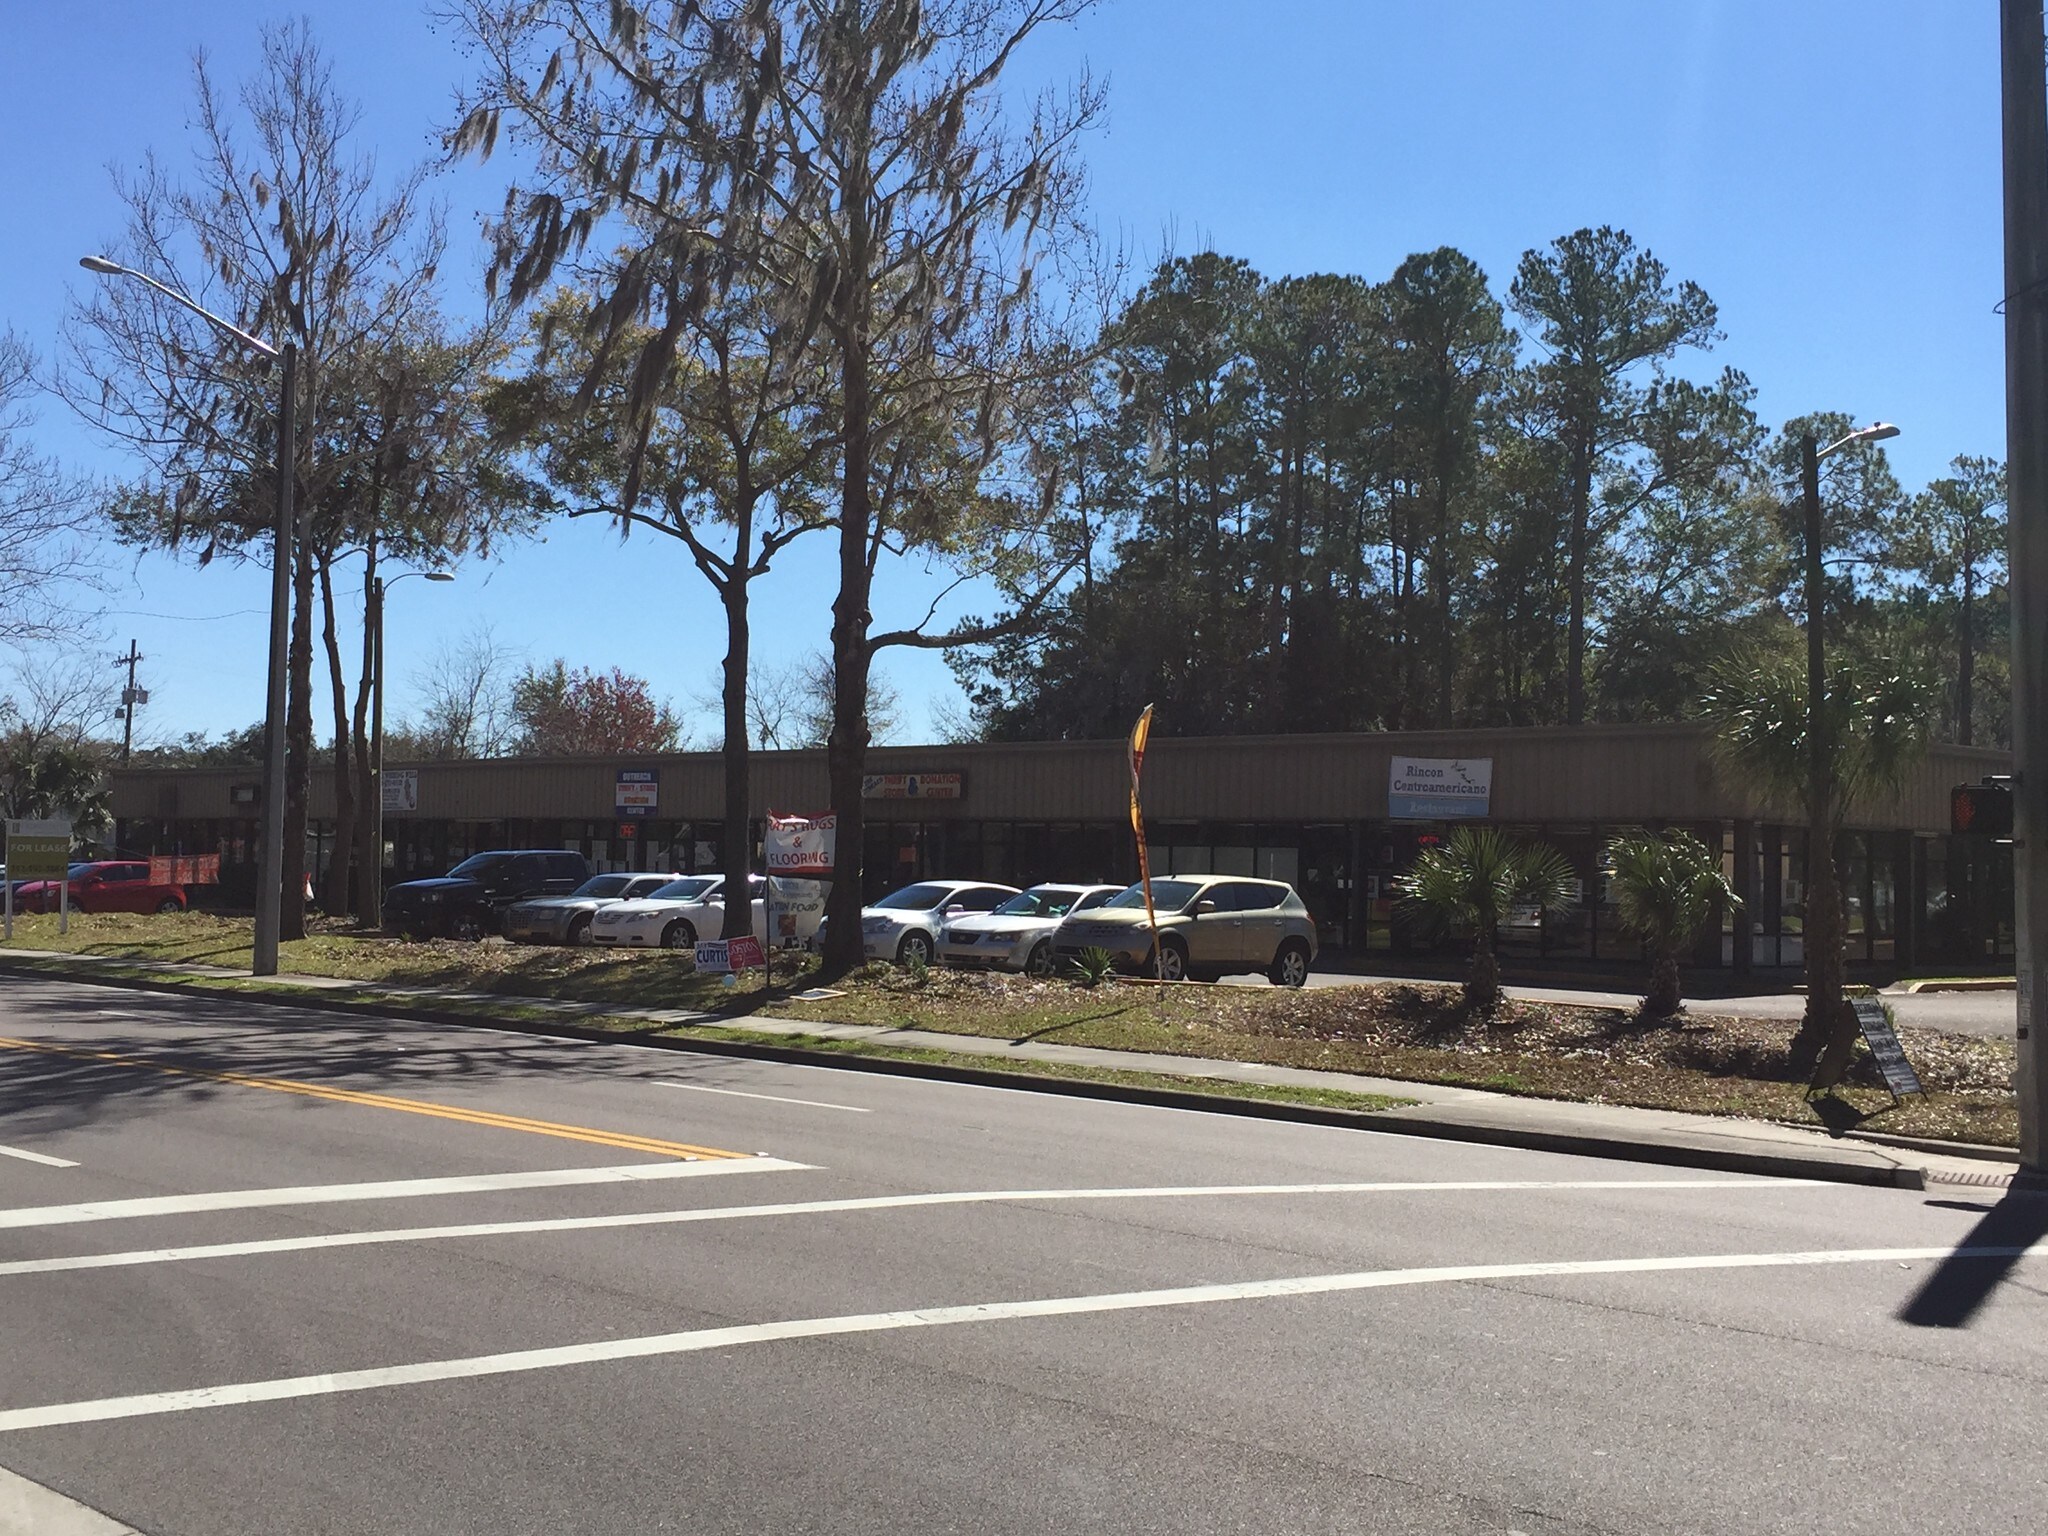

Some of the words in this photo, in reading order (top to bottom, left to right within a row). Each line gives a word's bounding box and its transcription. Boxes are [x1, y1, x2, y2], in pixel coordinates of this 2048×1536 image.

[1406, 765, 1443, 778] Rincon
[920, 774, 961, 785] DONATION
[1393, 780, 1487, 794] Centroamericano
[801, 816, 835, 832] RUGS
[11, 844, 32, 852] FOR
[36, 844, 67, 852] LEASE
[792, 837, 803, 848] &
[770, 851, 829, 865] FLOORING
[768, 902, 789, 912] ATIN
[791, 902, 818, 912] FOOD
[696, 949, 728, 963] CURTIS
